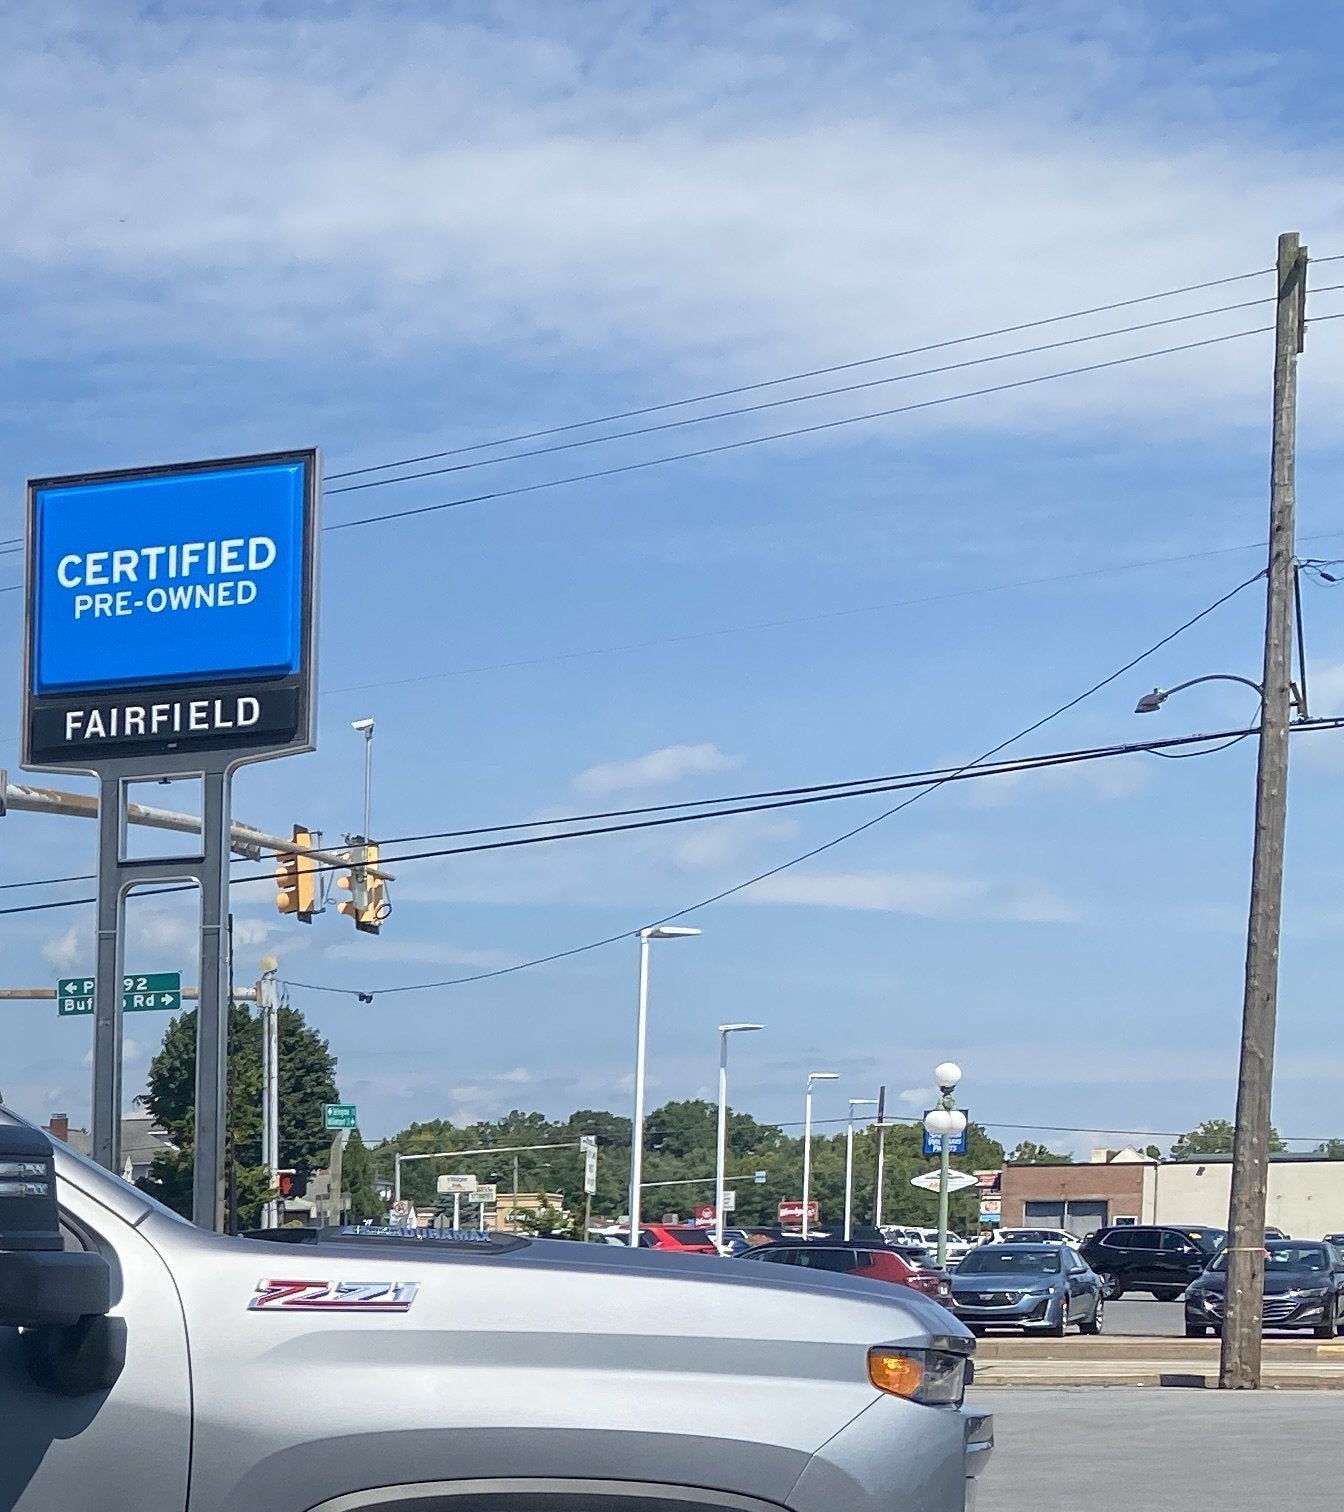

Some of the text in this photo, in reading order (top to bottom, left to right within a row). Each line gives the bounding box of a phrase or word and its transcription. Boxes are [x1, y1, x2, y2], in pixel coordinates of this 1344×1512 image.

[57, 536, 278, 589] CERTIFIED
[74, 580, 258, 620] PRE-OWNED
[64, 697, 261, 741] FAIRFIELD
[123, 977, 148, 992] 92
[133, 993, 155, 1008] Rd
[247, 1279, 422, 1312] Z71
